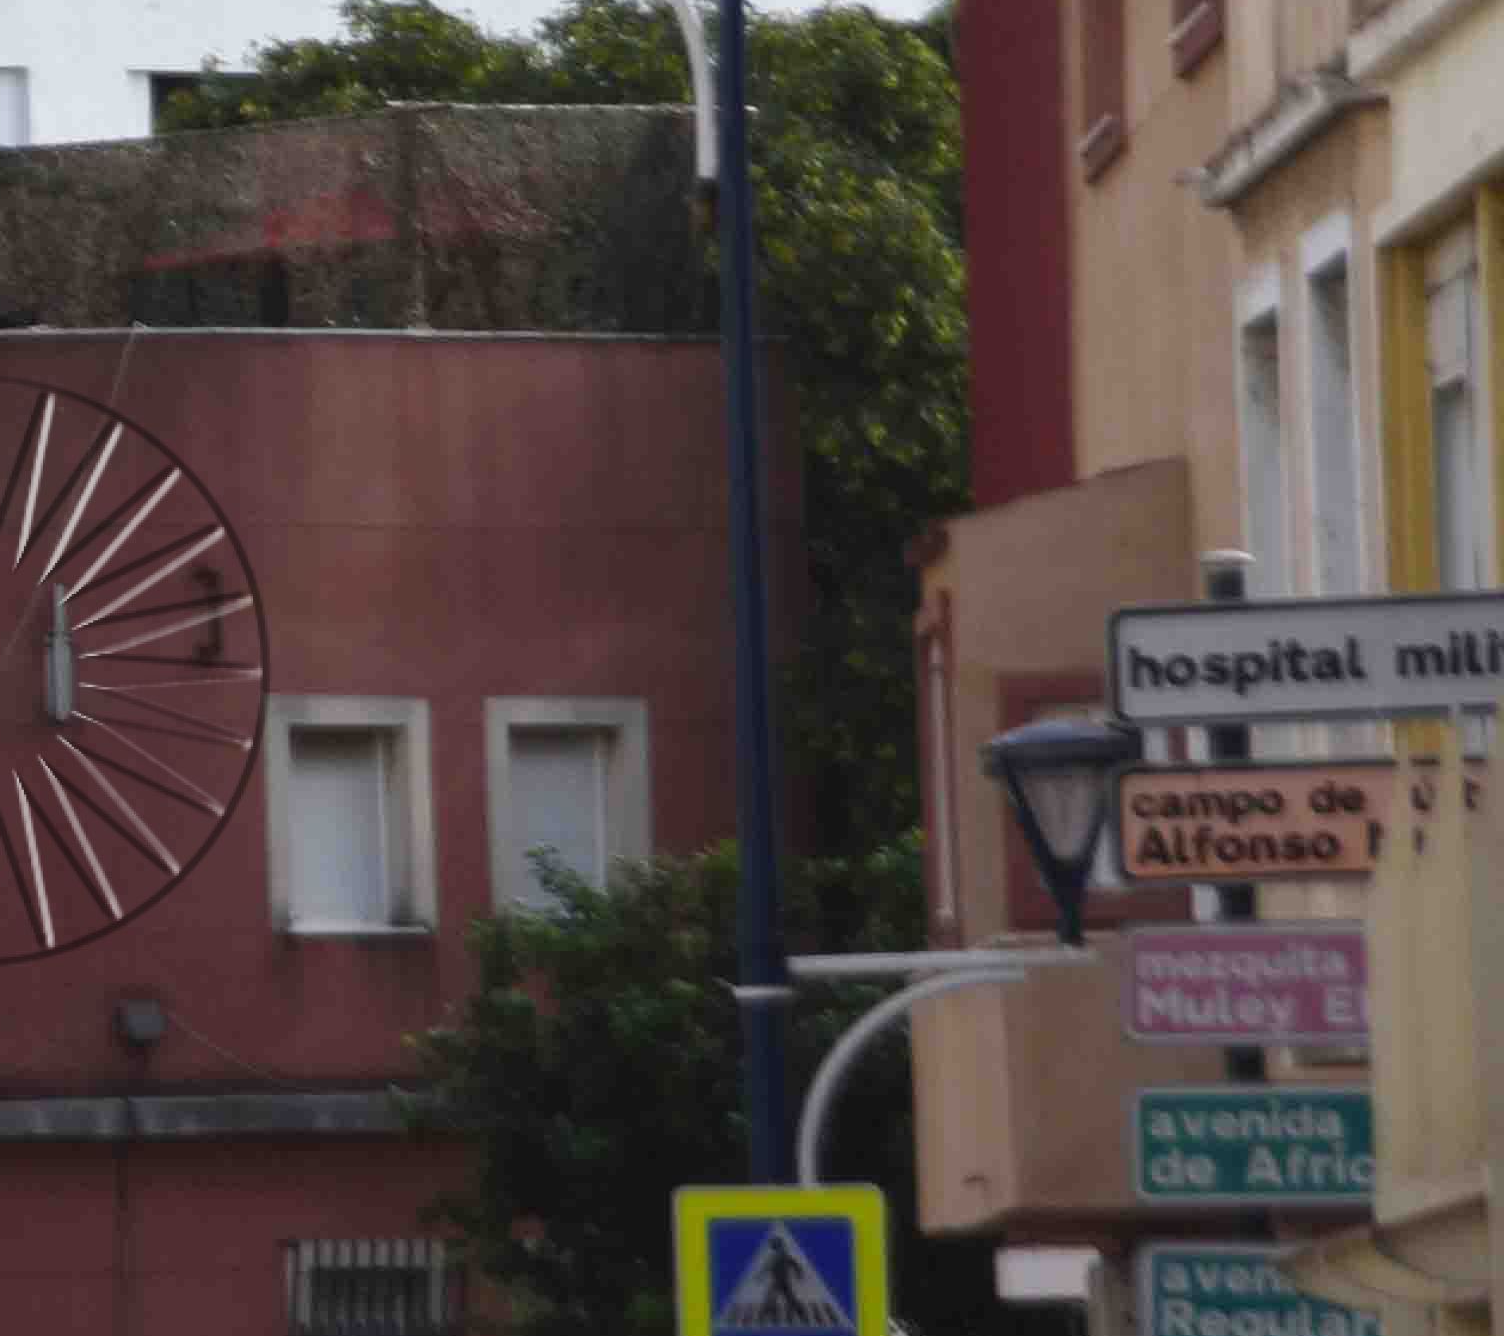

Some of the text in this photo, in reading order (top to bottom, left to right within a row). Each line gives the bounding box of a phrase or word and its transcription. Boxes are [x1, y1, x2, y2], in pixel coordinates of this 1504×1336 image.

[1125, 635, 1367, 697] hospital
[1131, 786, 1285, 824] campo
[1307, 778, 1366, 815] de
[1136, 822, 1341, 866] Alfonso
[1136, 942, 1348, 987] mezquita
[1136, 984, 1296, 1031] Muley
[1148, 1097, 1344, 1140] avenida
[1149, 1143, 1376, 1189] de Afric
[1159, 1261, 1300, 1295] aven
